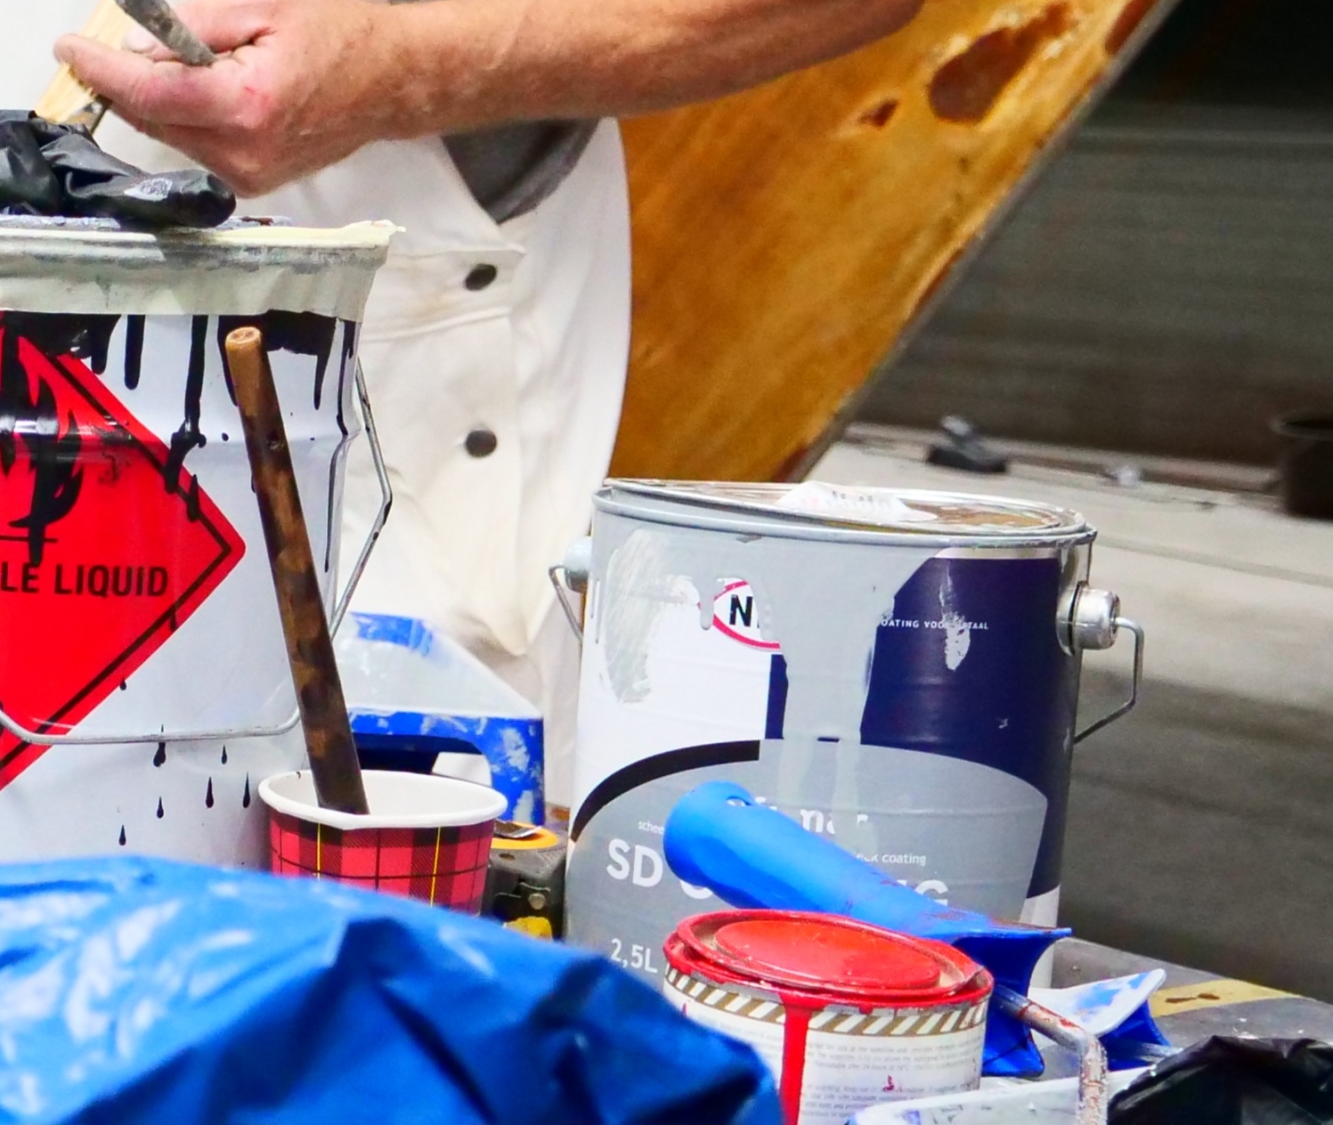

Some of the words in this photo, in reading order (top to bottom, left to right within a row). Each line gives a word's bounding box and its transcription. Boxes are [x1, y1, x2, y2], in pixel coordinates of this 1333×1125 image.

[53, 563, 169, 598] LIQUID
[880, 618, 921, 628] OATING
[605, 837, 664, 888] SD
[881, 852, 927, 867] coating
[610, 937, 659, 975] 2,5L
